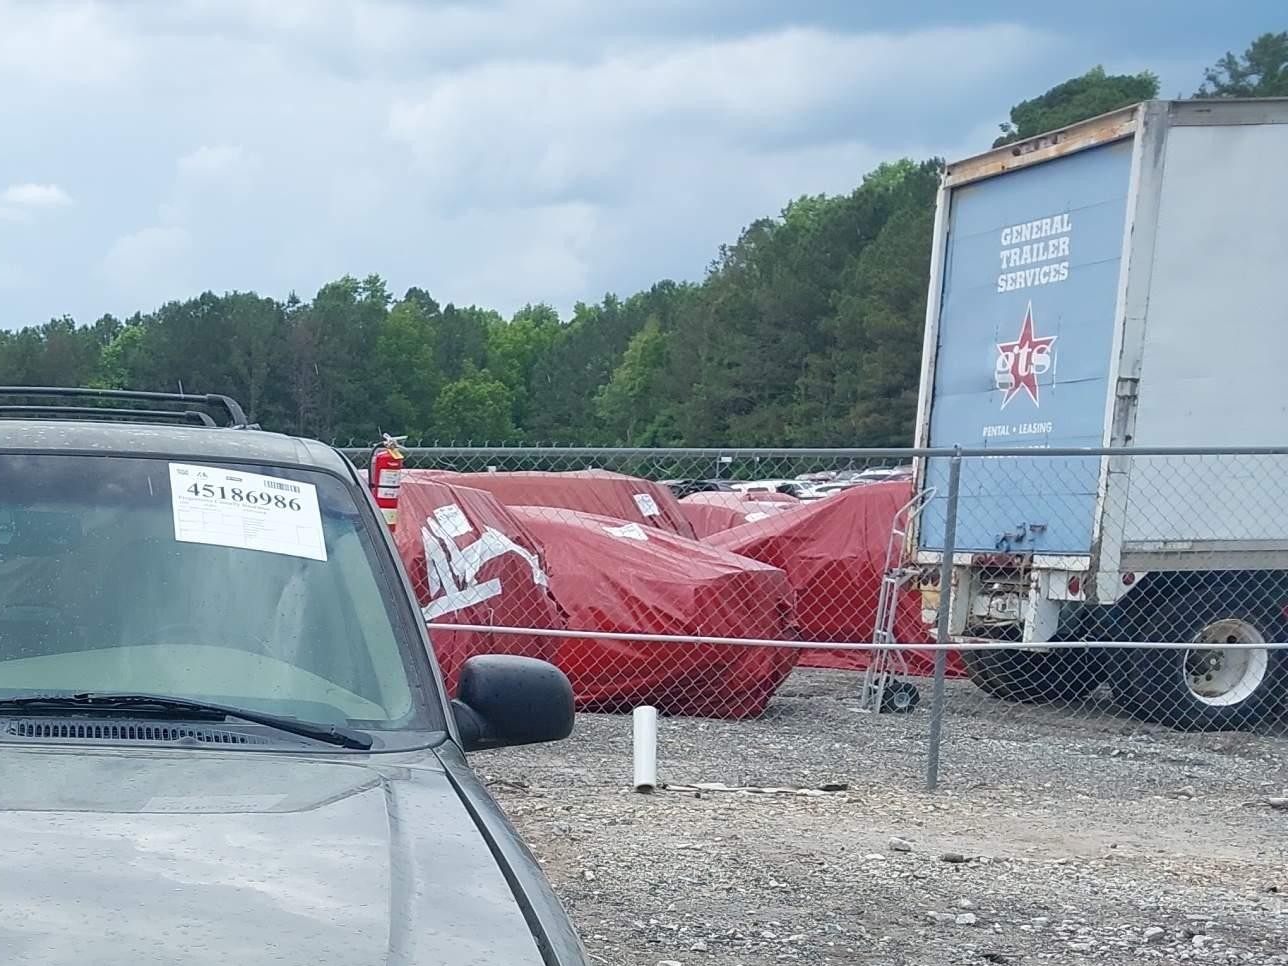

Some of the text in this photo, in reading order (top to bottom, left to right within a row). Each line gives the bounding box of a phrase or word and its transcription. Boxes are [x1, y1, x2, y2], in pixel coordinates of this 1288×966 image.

[1001, 213, 1073, 246] GENERAL
[1000, 237, 1070, 269] TRAILER
[997, 261, 1069, 293] SERVICES
[982, 422, 1053, 437] RENTAL LEASING
[186, 482, 302, 512] 45186986
